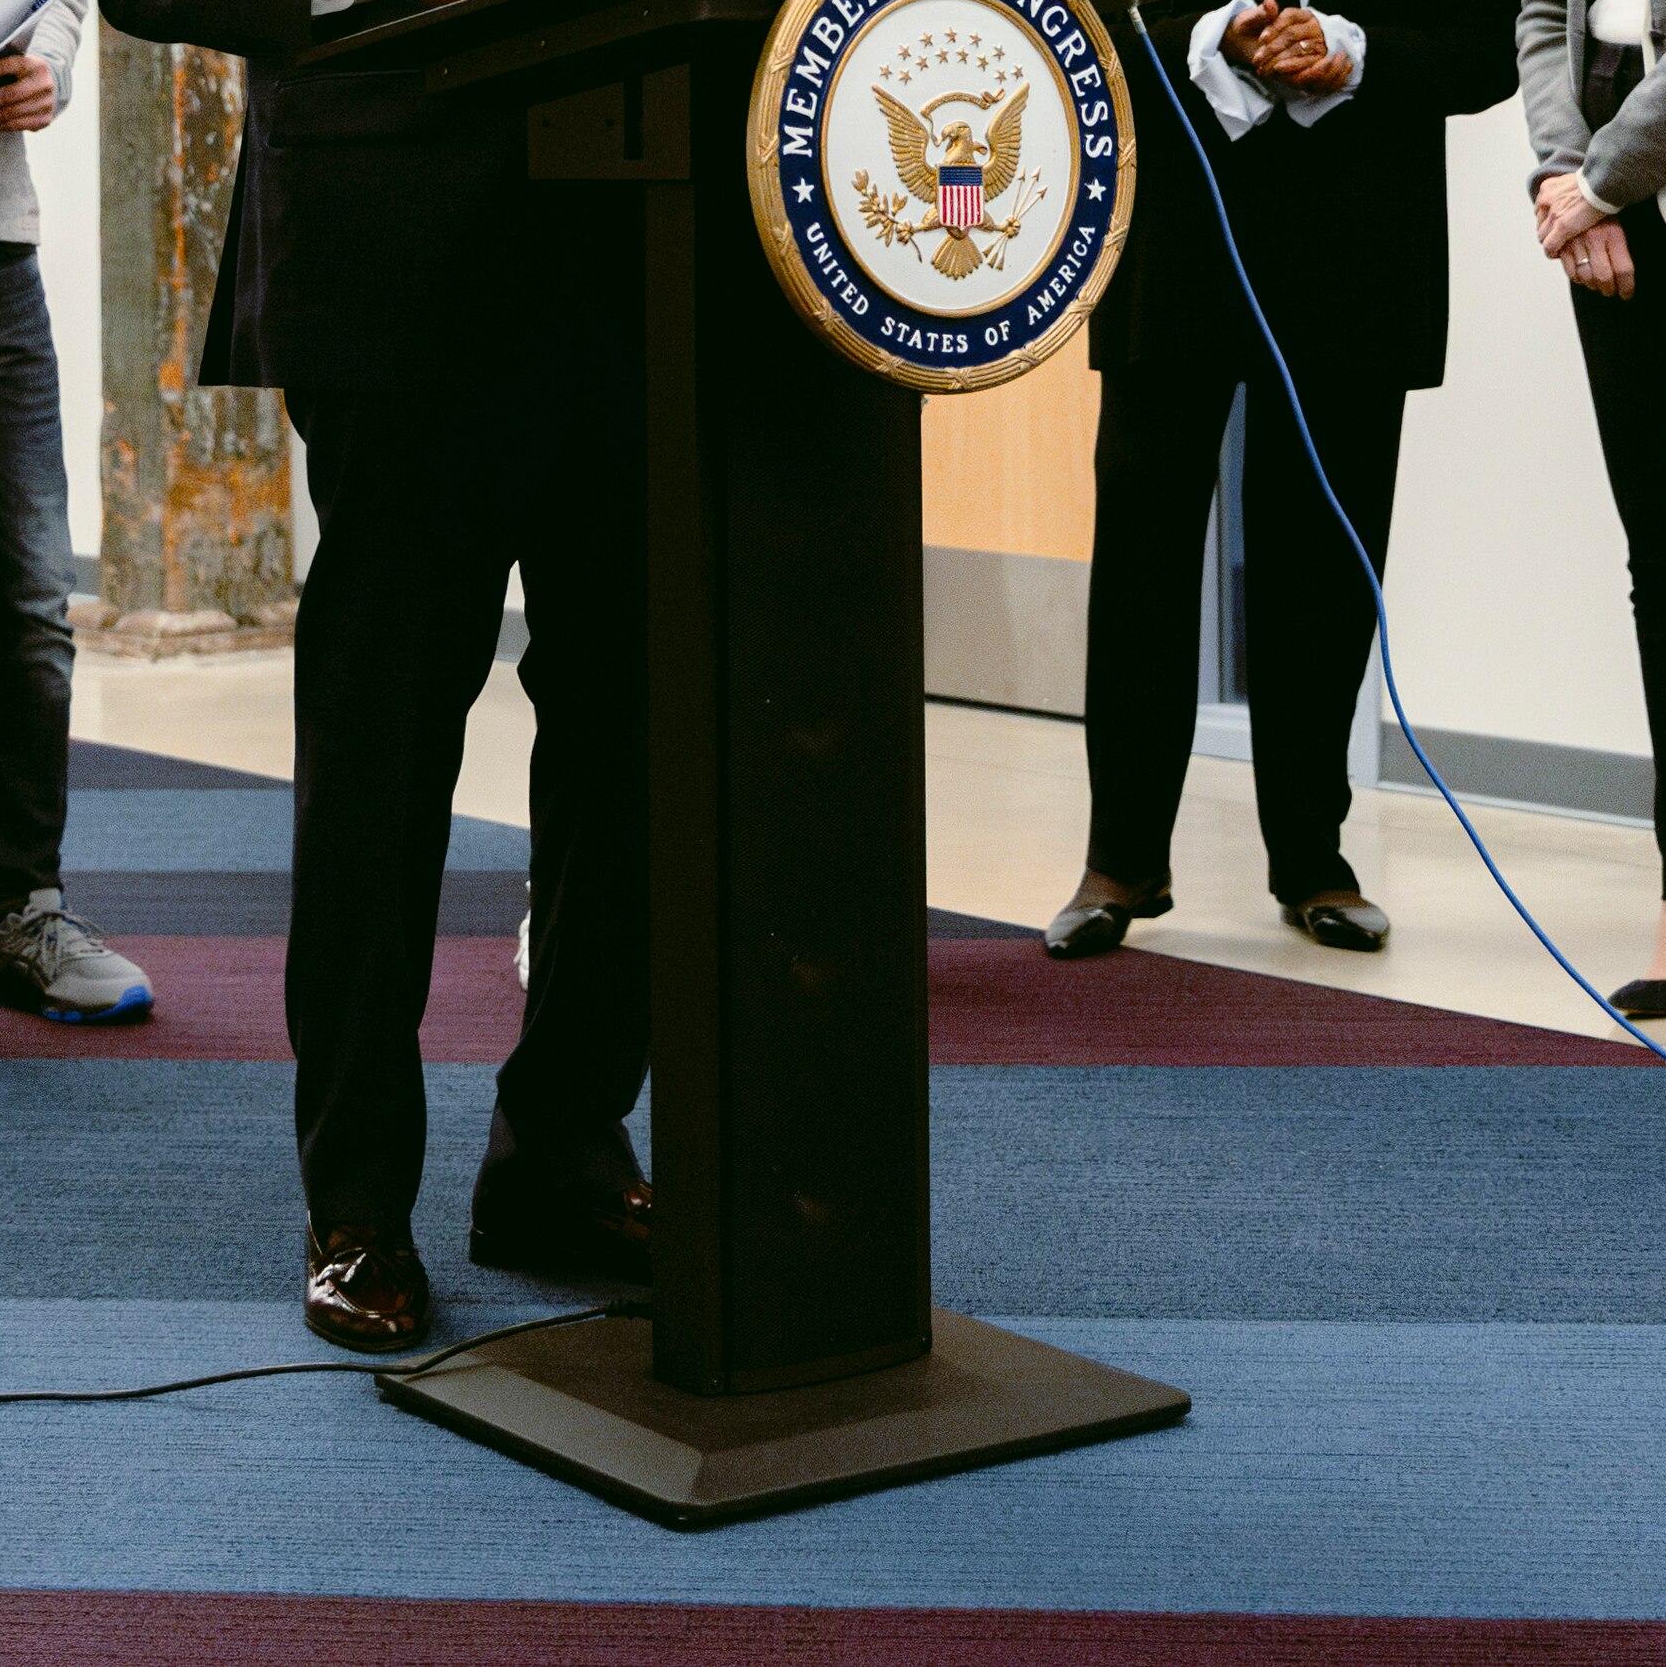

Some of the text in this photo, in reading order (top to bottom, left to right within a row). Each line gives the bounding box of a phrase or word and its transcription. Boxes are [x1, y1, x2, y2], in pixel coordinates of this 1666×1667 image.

[805, 221, 1097, 355] UNITED STATES OF AMERICA
